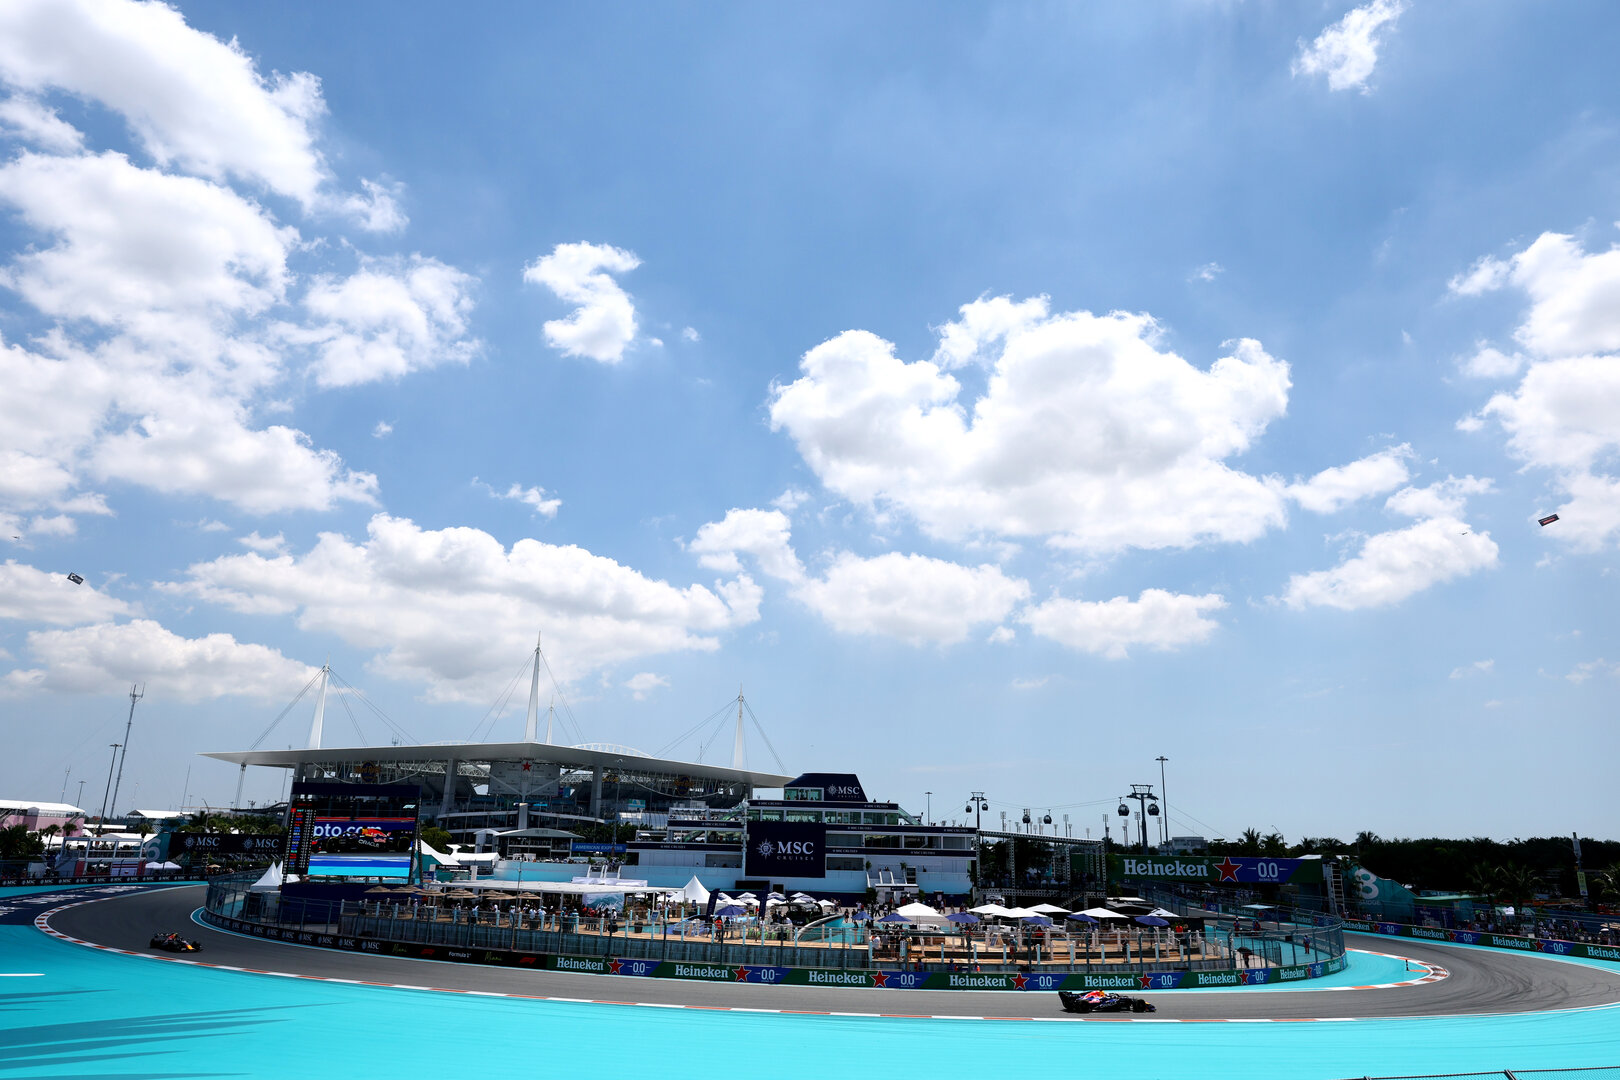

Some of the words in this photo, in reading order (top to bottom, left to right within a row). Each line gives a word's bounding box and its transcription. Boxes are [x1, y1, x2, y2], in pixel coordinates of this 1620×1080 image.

[196, 837, 220, 847] MSC
[255, 838, 280, 848] MSC
[358, 839, 379, 848] ORACLE
[777, 841, 814, 854] MSC
[145, 838, 162, 862] 6
[1124, 859, 1208, 876] Heineken
[1258, 862, 1278, 878] 0.0
[1355, 869, 1379, 899] 8
[1412, 928, 1444, 939] Heineken
[1492, 936, 1530, 949] Heineken
[1587, 946, 1620, 959] Heinek
[557, 957, 603, 971] Heineken
[675, 964, 728, 978] Heineken
[808, 971, 866, 984] Heineken
[1280, 968, 1305, 979] Heineken
[949, 975, 1006, 986] Heineken
[1084, 976, 1134, 987] Heineken
[1198, 974, 1236, 984] Heineken
